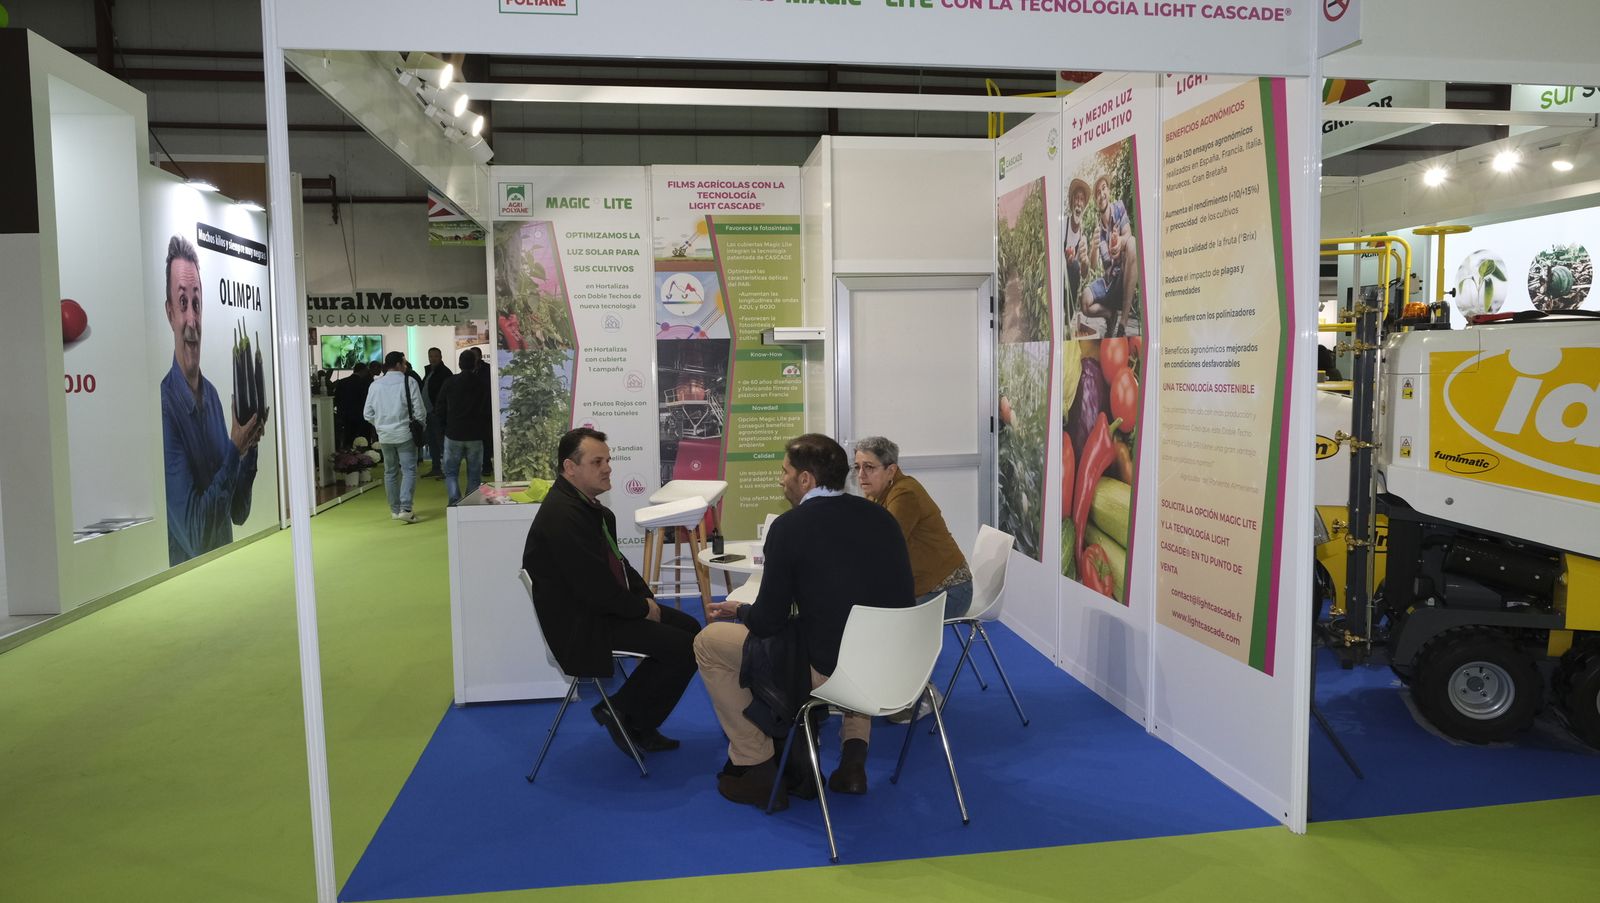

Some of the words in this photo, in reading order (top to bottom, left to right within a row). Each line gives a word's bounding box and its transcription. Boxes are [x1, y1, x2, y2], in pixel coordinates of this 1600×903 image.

[941, 0, 982, 9] CON
[989, 0, 1013, 10] LA
[1144, 2, 1196, 18] LIGHT
[1079, 117, 1084, 131] y
[1086, 99, 1113, 122] MEJOR
[1116, 88, 1132, 107] LUZ
[1071, 138, 1082, 150] EN
[1084, 132, 1094, 144] TU
[1096, 109, 1132, 138] CULTIVO
[1165, 120, 1200, 143] BENEFICIOS
[1176, 153, 1182, 163] de
[1183, 148, 1192, 160] 130
[1192, 141, 1214, 156] ensayos
[1214, 126, 1253, 148] agronómicos
[1166, 165, 1191, 179] realizados
[1192, 162, 1199, 170] en
[1206, 165, 1228, 180] Bretaña
[697, 179, 750, 189] AGRÍCOLAS
[546, 196, 590, 208] MAGIC
[604, 198, 632, 210] LITE
[697, 190, 756, 200] TECNOLOGÍA
[1165, 206, 1188, 220] Aumenta
[1188, 204, 1193, 214] el
[1194, 194, 1228, 211] rendimiento
[1170, 218, 1198, 234] precocidad
[1200, 214, 1207, 224] de
[1208, 212, 1216, 222] los
[1216, 206, 1239, 220] cultivos
[565, 231, 628, 240] OPTIMIZAMOS
[629, 232, 640, 240] LA
[1165, 248, 1182, 259] Mejora
[1182, 246, 1188, 255] la
[1188, 243, 1208, 254] calidad
[1209, 242, 1216, 250] de
[1216, 238, 1222, 248] la
[1223, 234, 1238, 246] fruta
[1165, 274, 1183, 285] Reduce
[1184, 273, 1189, 282] el
[1190, 269, 1211, 282] impacto
[1212, 268, 1220, 276] de
[1220, 264, 1240, 277] plagas
[1240, 264, 1245, 274] y
[220, 278, 262, 312] OLIMPIA
[1165, 286, 1200, 298] enfermedades
[308, 312, 370, 324] RICIÓN
[381, 314, 460, 324] VEGETAL
[1165, 316, 1172, 324] No
[1172, 313, 1196, 322] interfiere
[1196, 312, 1206, 321] con
[1207, 310, 1215, 320] los
[1216, 308, 1256, 320] polinizadores
[1164, 346, 1190, 356] Beneficios
[1190, 344, 1226, 356] agronómicos
[1226, 344, 1258, 355] mejorados
[1164, 361, 1170, 369] en
[1171, 360, 1201, 369] condiciones
[1202, 359, 1241, 368] desfavorables
[64, 374, 96, 394] OJO
[1163, 383, 1175, 391] UNA
[1176, 382, 1212, 392] TECNOLOGÍA
[1214, 383, 1255, 394] SOSTENIBLE
[1433, 450, 1490, 469] fumimatic
[1161, 498, 1186, 512] SOLICITA
[1186, 504, 1194, 515] LA
[1194, 506, 1218, 521] OPCIÓN
[1219, 514, 1241, 526] MAGIC
[1242, 518, 1257, 531] LITE
[1161, 520, 1165, 528] Y
[1165, 521, 1173, 530] LA
[1173, 522, 1211, 543] TECNOLOGÍA
[1211, 532, 1230, 547] LIGHT
[1160, 561, 1178, 575] VENTA
[1191, 550, 1199, 561] EN
[1200, 552, 1209, 563] TU
[1210, 554, 1232, 572] PUNTO
[1233, 563, 1242, 575] DE
[1171, 587, 1242, 623] contact@lightcascade.fr
[1171, 609, 1240, 646] www.lightcascade.com
